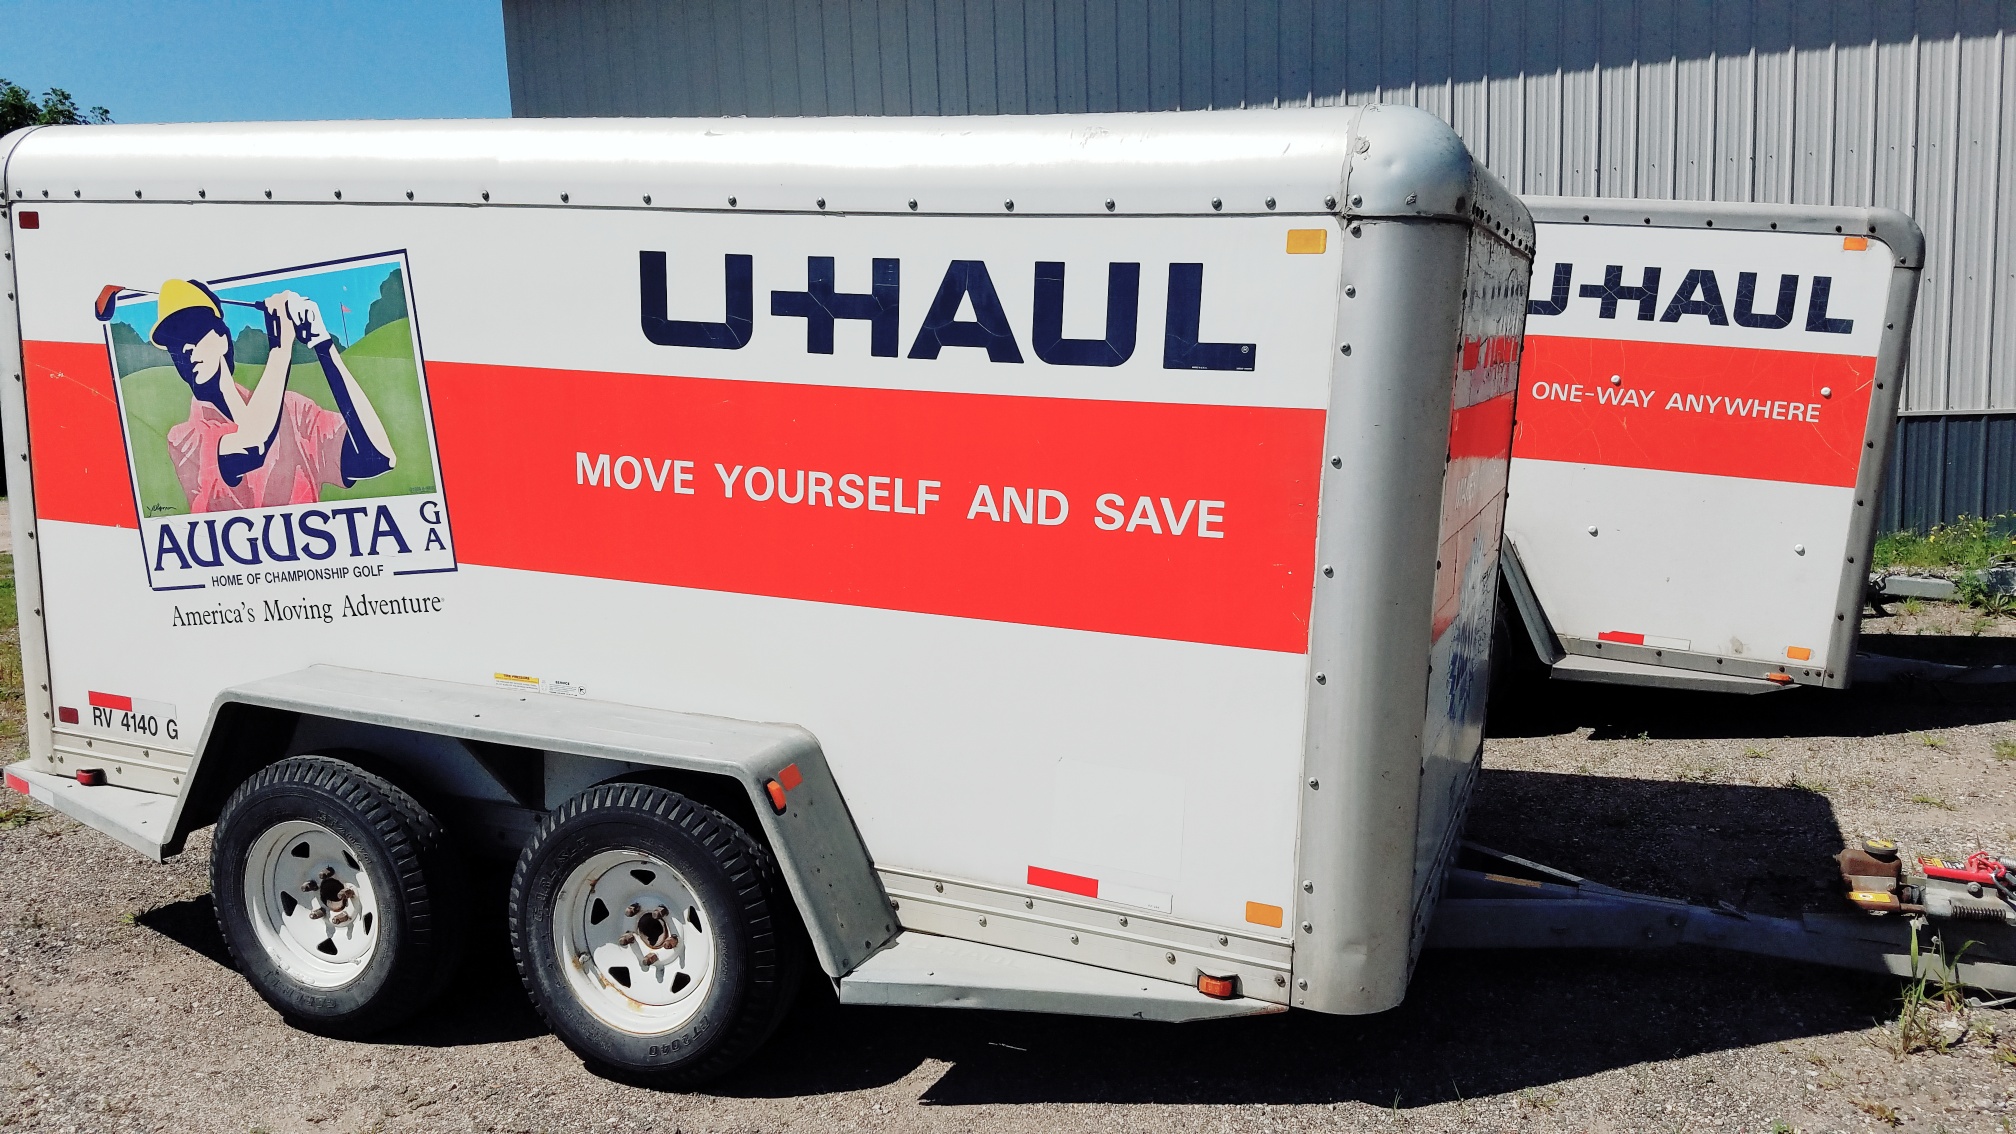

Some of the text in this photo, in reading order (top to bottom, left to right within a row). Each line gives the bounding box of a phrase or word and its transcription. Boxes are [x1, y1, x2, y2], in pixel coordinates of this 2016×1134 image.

[639, 250, 1256, 372] U-HAUL
[1531, 381, 1822, 423] ONE-WAY ANYWHERE
[576, 451, 1225, 539] MOVE YOURSELF AND SAVE
[154, 504, 412, 571] AUGUSTA
[211, 564, 384, 587] HOME OF CHAMPIONSHIP GOLF
[172, 594, 442, 627] America's Moving Adventure
[93, 707, 179, 740] RV 4140 G
